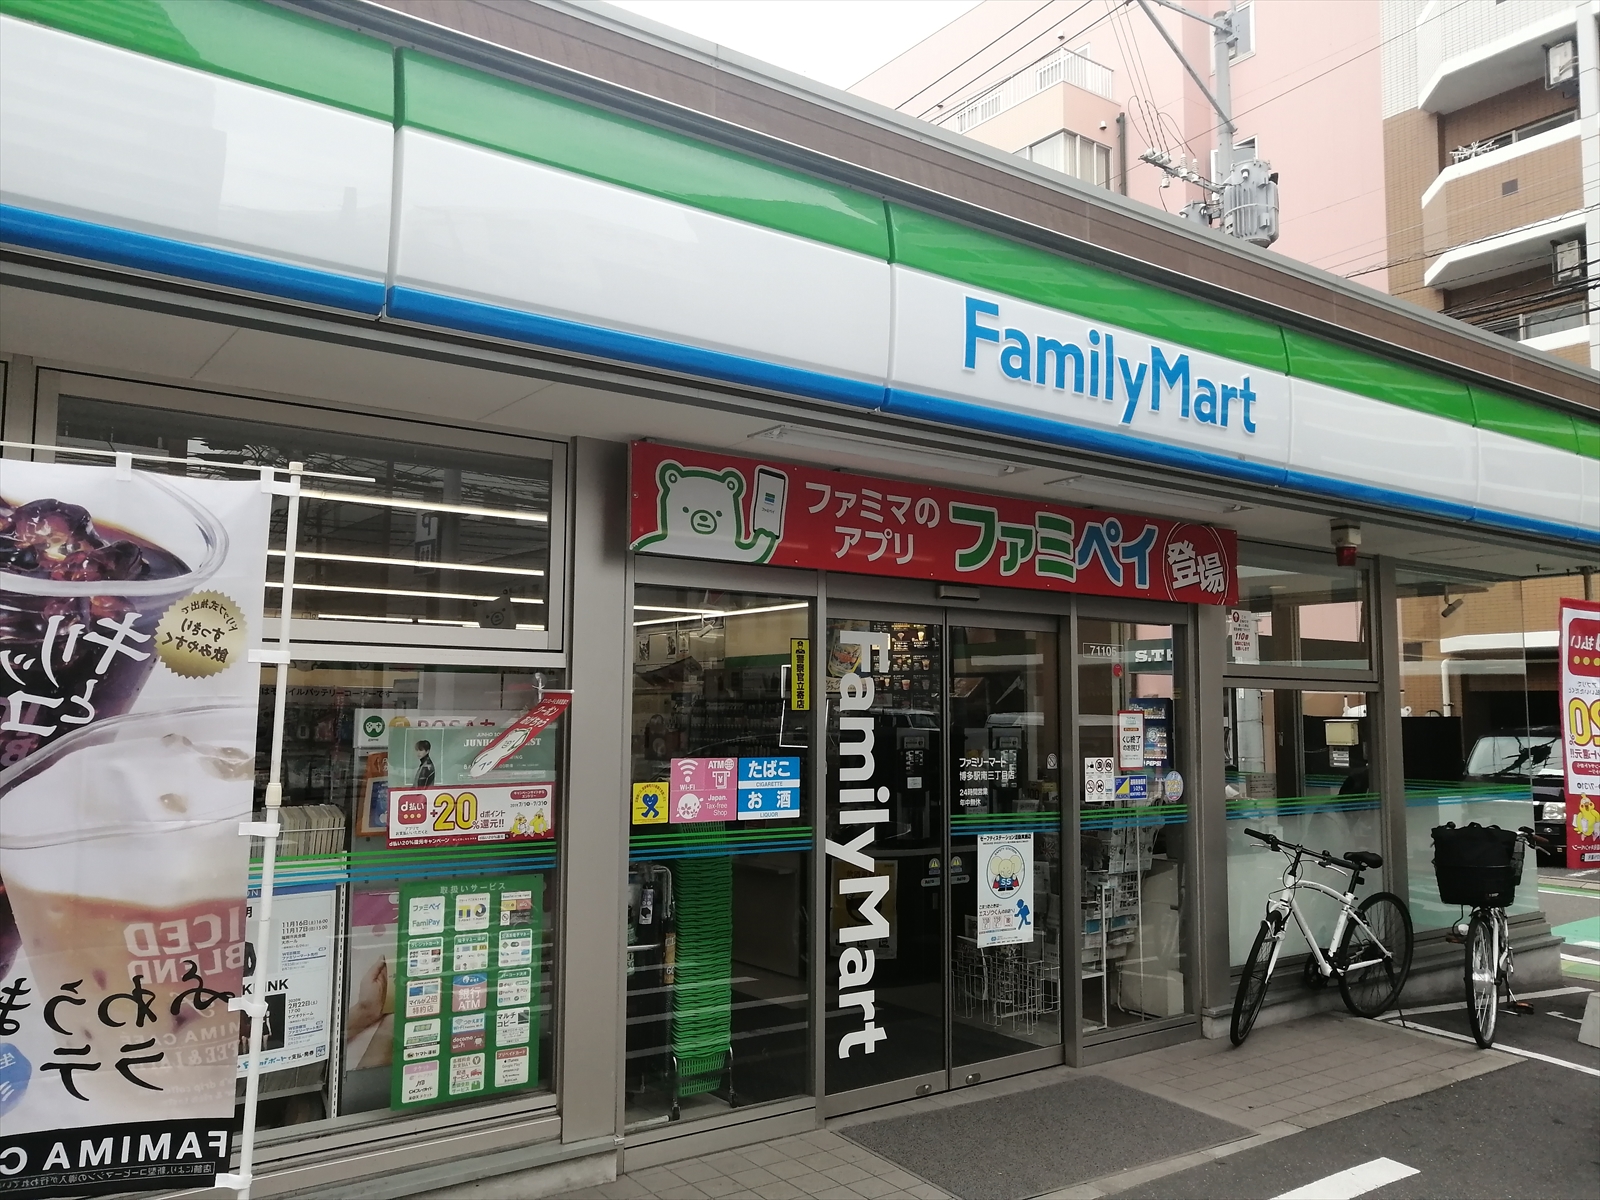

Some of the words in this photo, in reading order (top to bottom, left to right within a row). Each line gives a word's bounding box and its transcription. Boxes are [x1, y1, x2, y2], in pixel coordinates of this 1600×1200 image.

[963, 296, 1257, 434] FamilyMart
[806, 481, 941, 529] ファミマの
[835, 525, 914, 565] アプリ
[949, 501, 1158, 589] ファミペイ
[1168, 540, 1226, 595] 登場
[708, 760, 725, 769] ATM
[748, 760, 791, 778] たばこ
[959, 757, 1007, 769] ファミリーマート
[959, 770, 1016, 782] 博多駅南三丁目店
[959, 788, 988, 797] 24時間営業
[400, 800, 424, 812] d払い
[705, 802, 728, 810] Tax-free
[713, 809, 728, 817] Shop
[826, 630, 890, 1059] FamilyMart
[440, 883, 505, 894] 取扱いサービス
[413, 903, 441, 912] ファミペイ
[412, 919, 441, 929] FamiPay
[458, 986, 481, 999] 銀行
[458, 999, 481, 1011] ATM
[497, 1011, 516, 1020] マルチ
[497, 1019, 516, 1028] コピー
[452, 1035, 474, 1043] docomo
